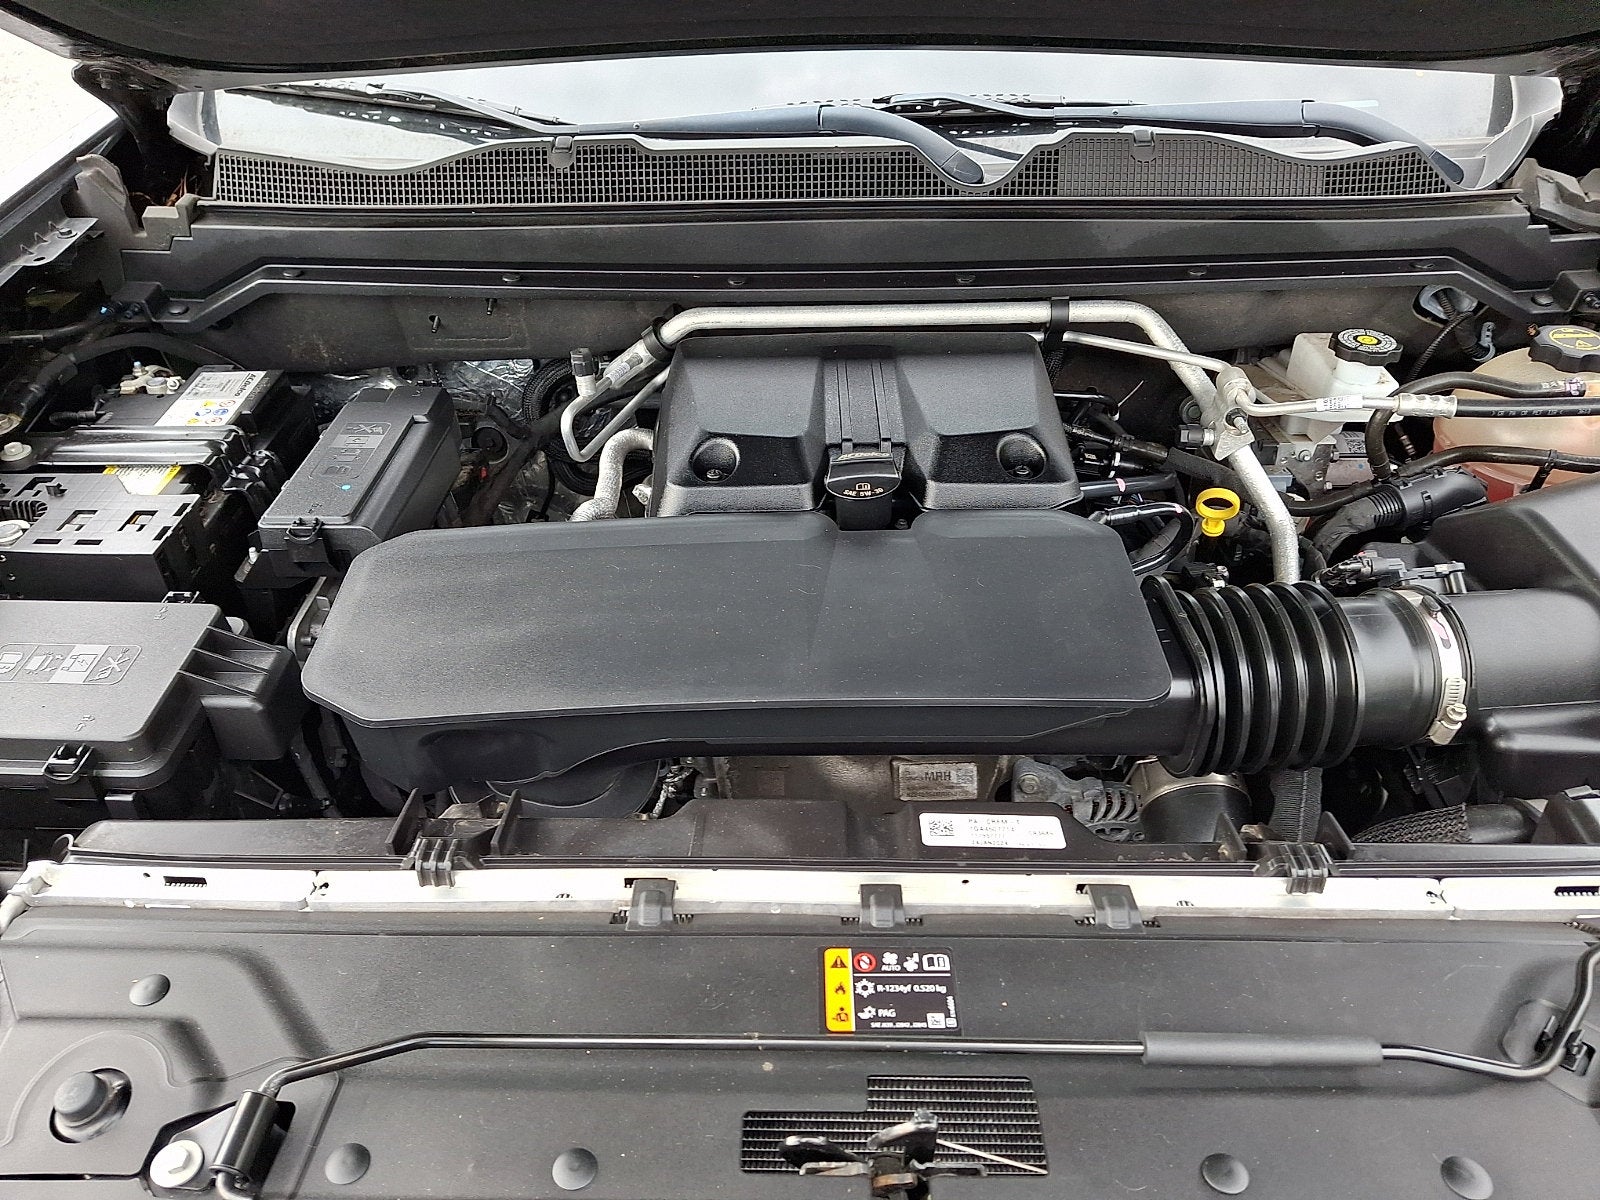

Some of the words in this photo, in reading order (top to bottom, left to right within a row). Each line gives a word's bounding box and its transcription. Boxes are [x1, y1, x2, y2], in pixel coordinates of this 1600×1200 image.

[843, 489, 857, 497] SAE
[860, 487, 884, 497] 5W-30
[924, 770, 952, 782] MRH
[881, 964, 901, 972] AUTO
[876, 984, 912, 994] R-1234yf
[936, 984, 947, 994] kg
[878, 1008, 896, 1018] PAG
